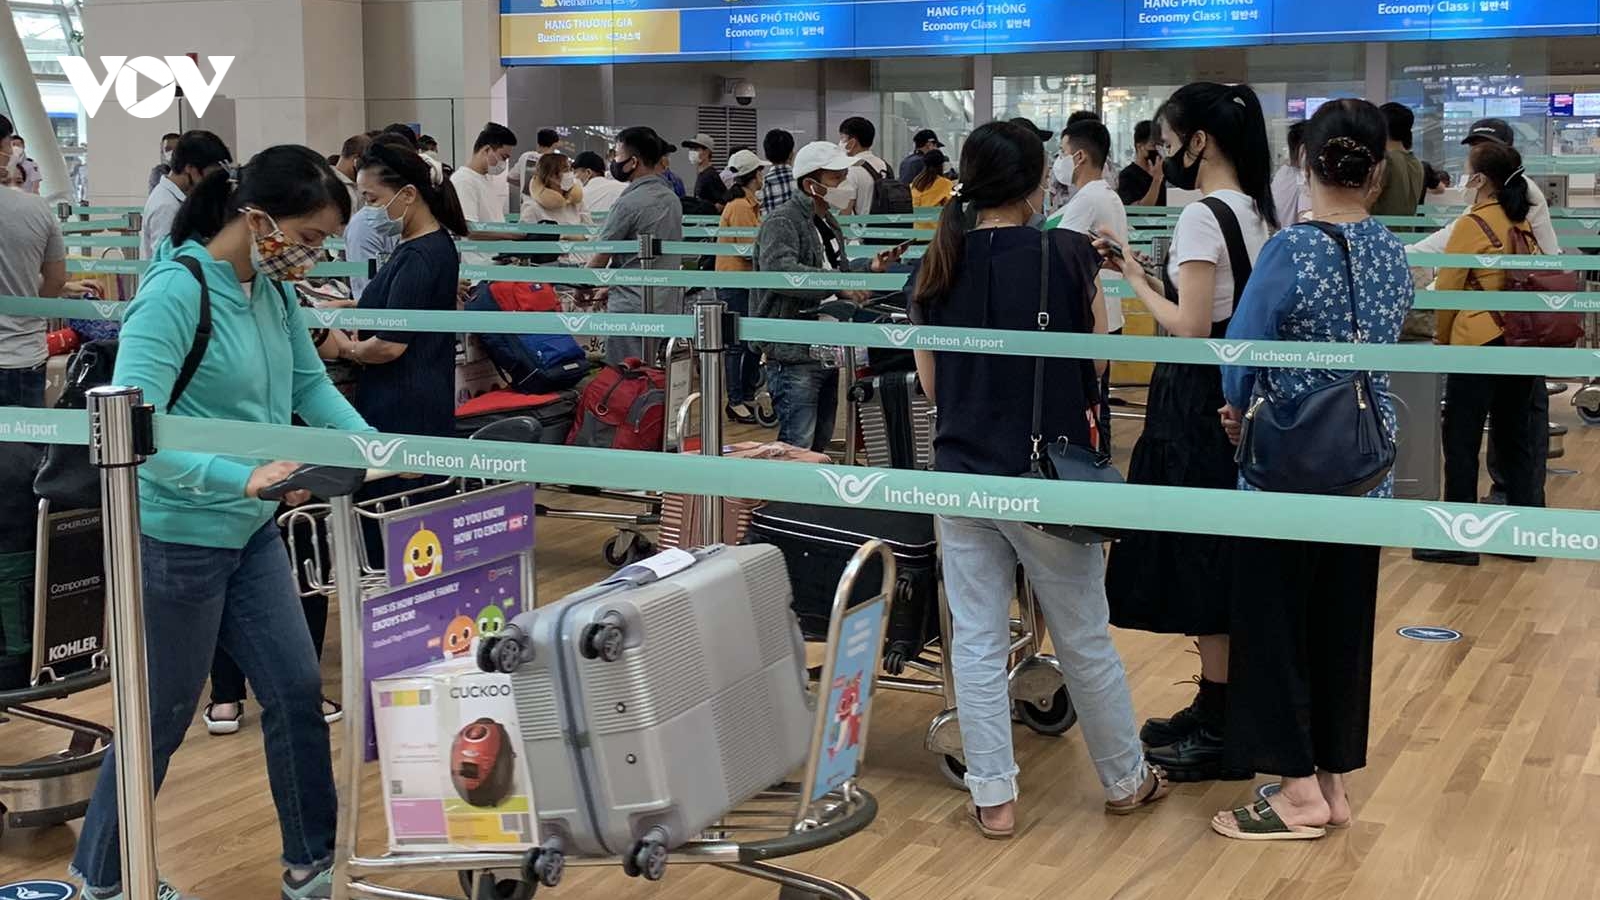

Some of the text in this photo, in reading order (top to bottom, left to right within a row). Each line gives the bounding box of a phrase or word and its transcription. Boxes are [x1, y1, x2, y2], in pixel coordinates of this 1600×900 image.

[926, 6, 958, 18] HẠNG
[987, 3, 1026, 14] THÔNG
[1378, 2, 1469, 15] Economy Class
[730, 14, 759, 26] HẠNG
[784, 10, 820, 22] THÔNG
[1139, 10, 1220, 24] Economy Class
[726, 26, 794, 38] Economy Class
[923, 20, 998, 32] Economy Class
[840, 278, 866, 288] Airport
[340, 317, 408, 328] Incheon Airport
[590, 320, 664, 334] Incheon Airport
[916, 336, 1004, 350] Incheon Airport
[1250, 350, 1354, 366] Incheon Airport
[14, 422, 58, 438] Airport
[403, 449, 528, 476] Incheon Airport
[884, 485, 1040, 514] Incheon Airport
[465, 512, 482, 526] YOU
[1513, 526, 1598, 550] Incheo
[51, 575, 100, 594] Components
[49, 636, 98, 662] KOHLER
[450, 684, 512, 699] CUCKOO
